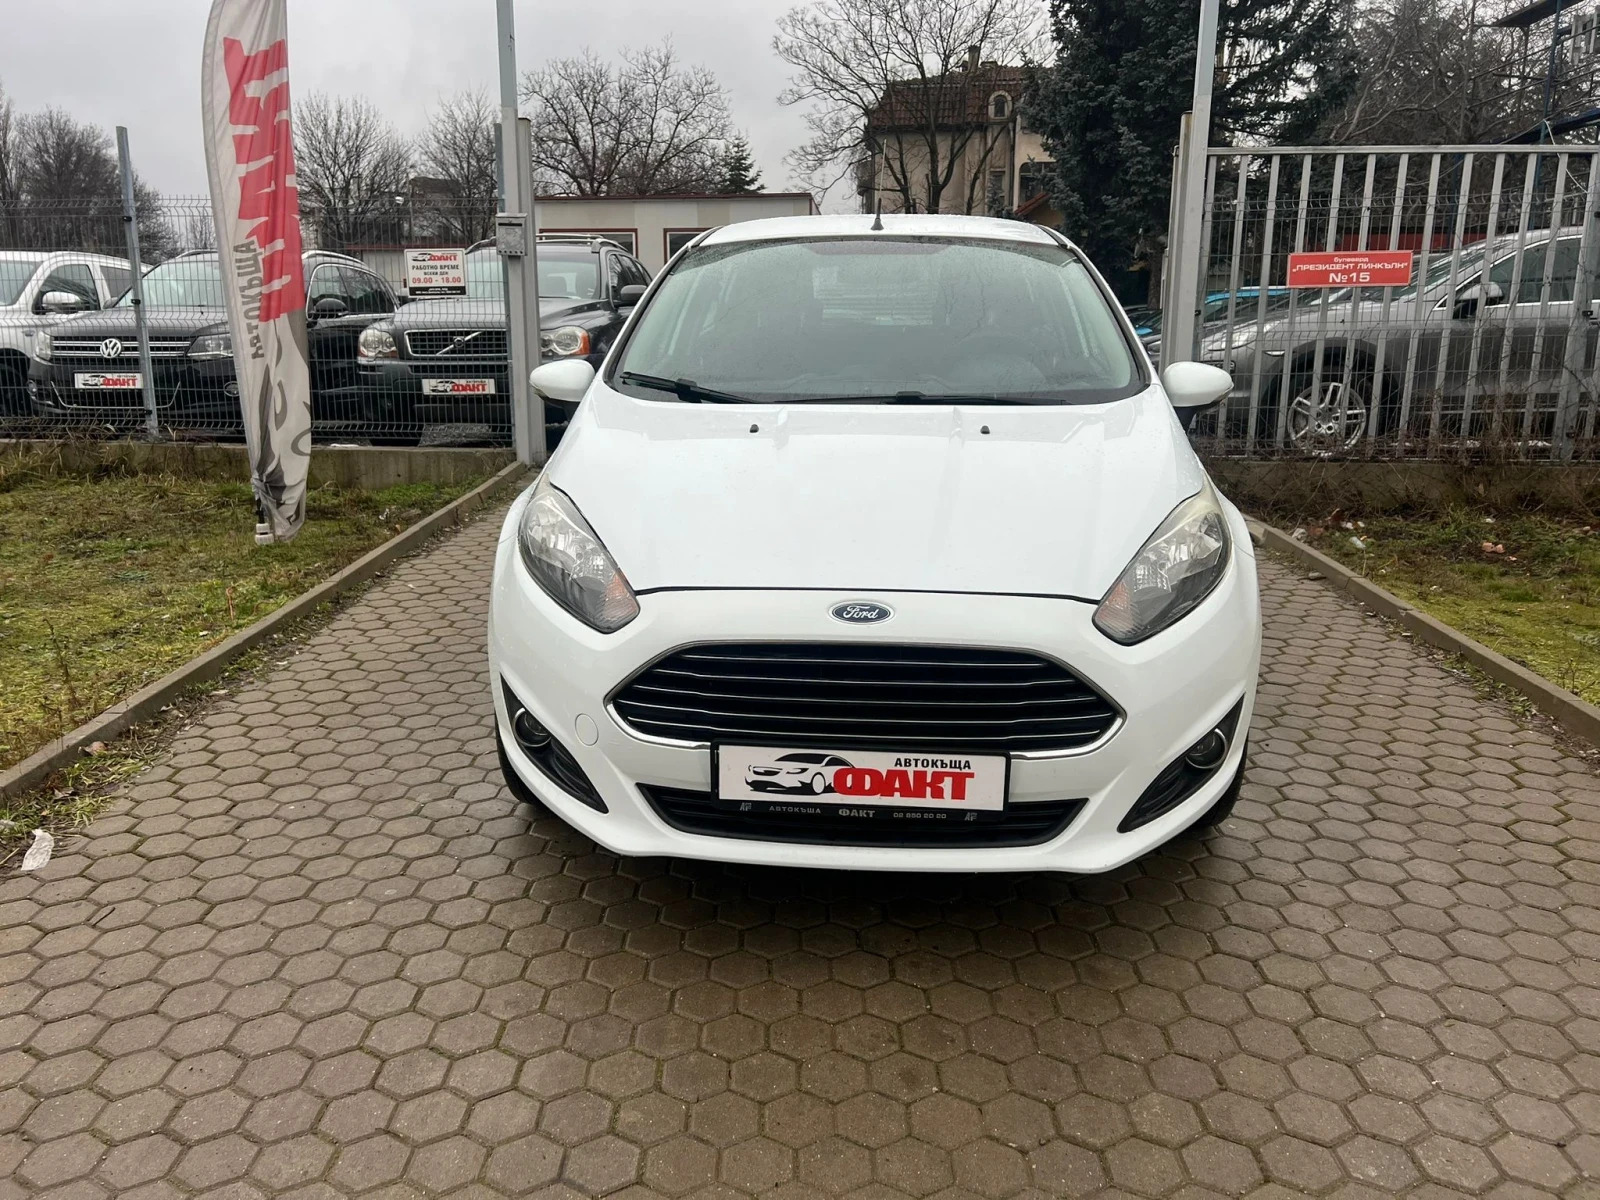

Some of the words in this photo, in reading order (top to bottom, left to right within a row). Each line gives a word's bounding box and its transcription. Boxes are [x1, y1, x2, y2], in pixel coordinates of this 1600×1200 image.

[843, 606, 880, 618] Ford
[895, 757, 971, 770] АВТОКЪЩА
[833, 767, 975, 800] ФАКТ
[839, 809, 875, 817] ФАКТ
